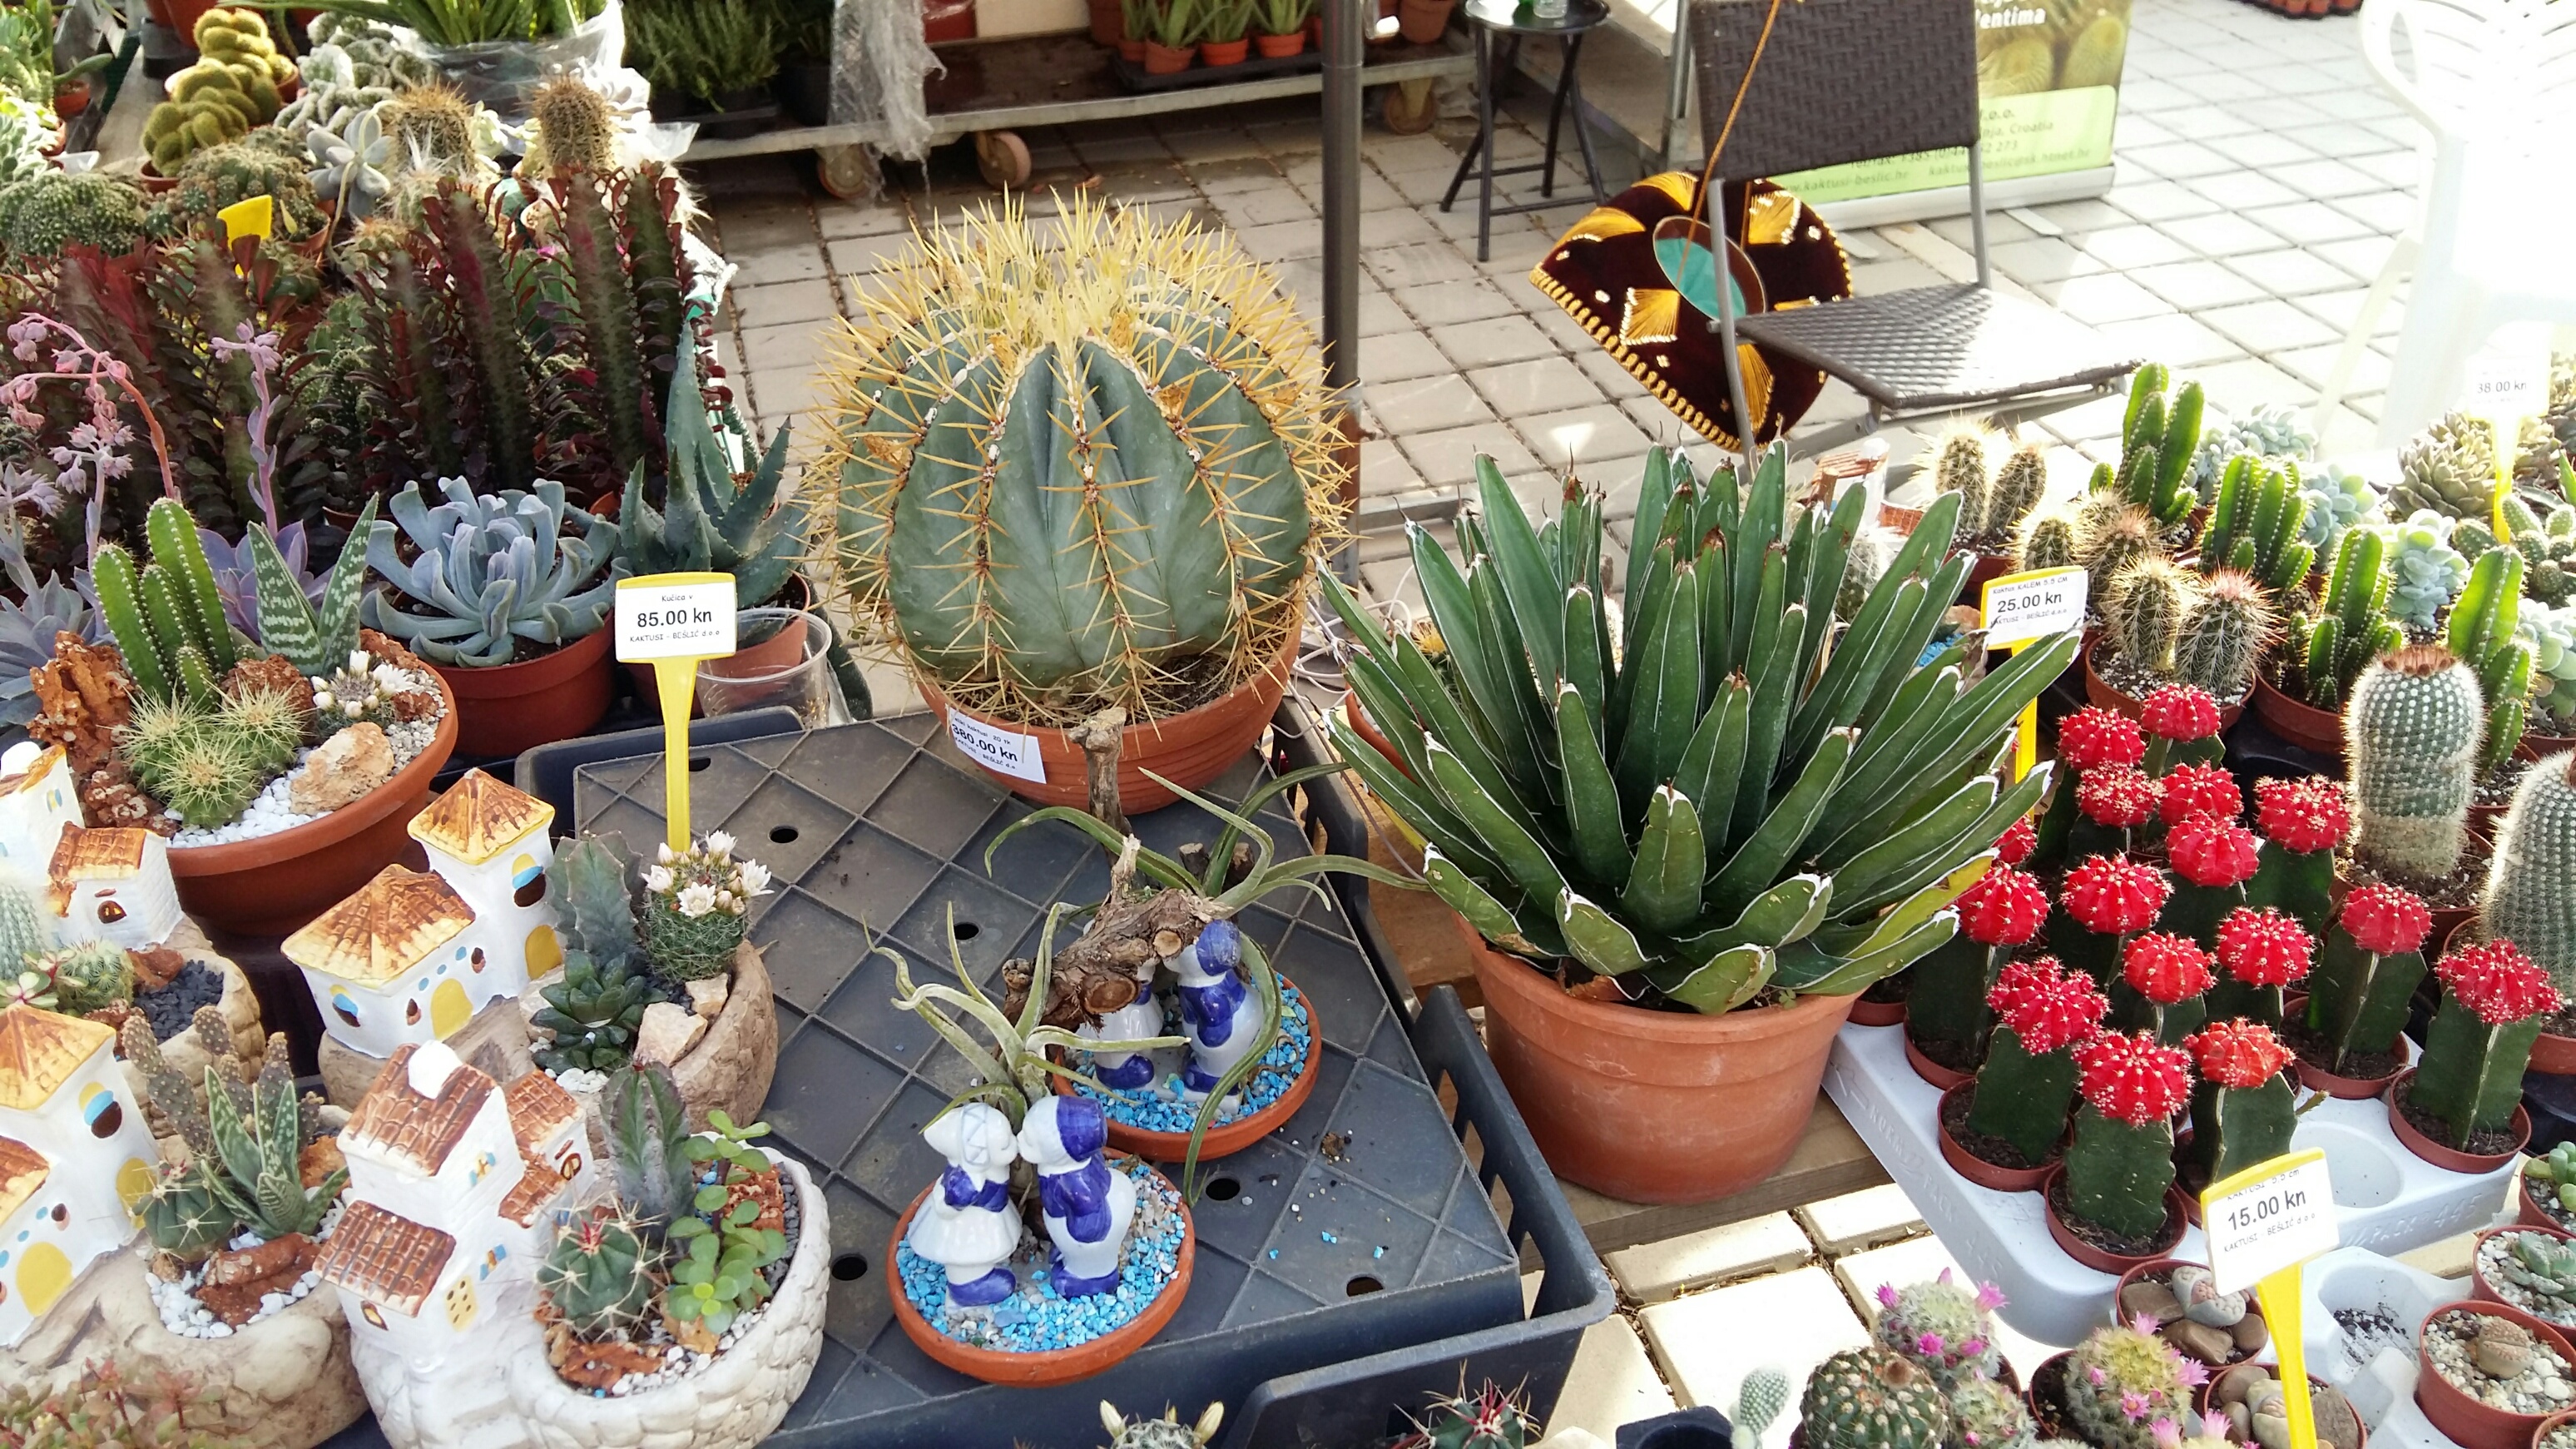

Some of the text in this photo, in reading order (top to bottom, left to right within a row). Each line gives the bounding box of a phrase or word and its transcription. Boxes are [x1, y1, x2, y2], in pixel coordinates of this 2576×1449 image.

[2477, 380, 2527, 394] 3800 kn
[1993, 586, 2015, 594] Kaktus
[2017, 581, 2041, 590] KALEM
[661, 593, 686, 603] Kučica
[1997, 591, 2062, 613] 25.00 kn
[637, 608, 712, 628] 85.00 kn
[672, 629, 699, 639] BEŠLIĆ
[952, 723, 1018, 762] 380.00 kn
[2289, 1169, 2300, 1178] cm
[2228, 1190, 2306, 1231] 15.00 kn
[2224, 1233, 2258, 1253] KAKTUSI
[2267, 1217, 2294, 1236] BEŠLIĆ
